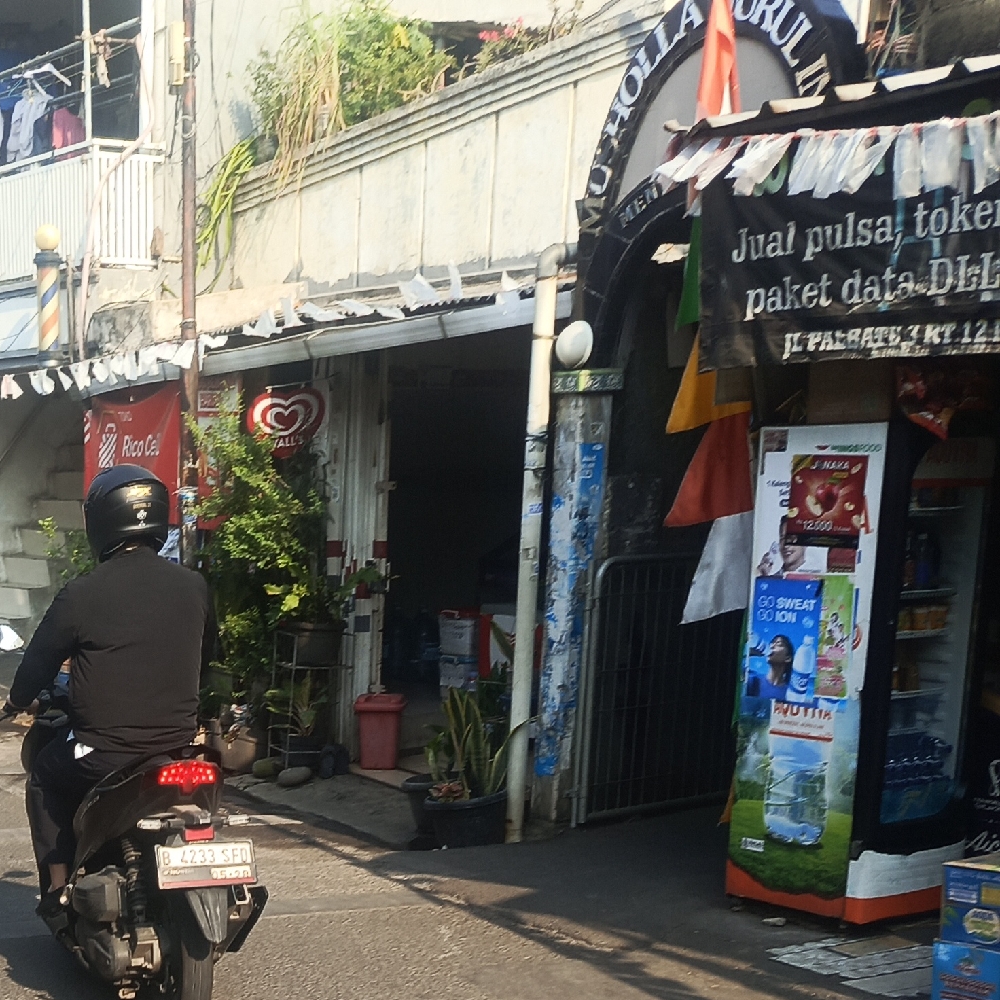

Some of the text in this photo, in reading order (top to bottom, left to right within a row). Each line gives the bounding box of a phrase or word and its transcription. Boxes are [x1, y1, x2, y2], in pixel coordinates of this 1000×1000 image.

[732, 0, 814, 68] URUL
[731, 220, 797, 264] Jual
[801, 211, 903, 262] pulsa,
[743, 273, 833, 321] paket
[840, 264, 916, 306] data
[756, 608, 798, 624] GO ION
[757, 595, 817, 612] GO SWEAT
[162, 850, 172, 866] B
[180, 847, 216, 864] 4233
